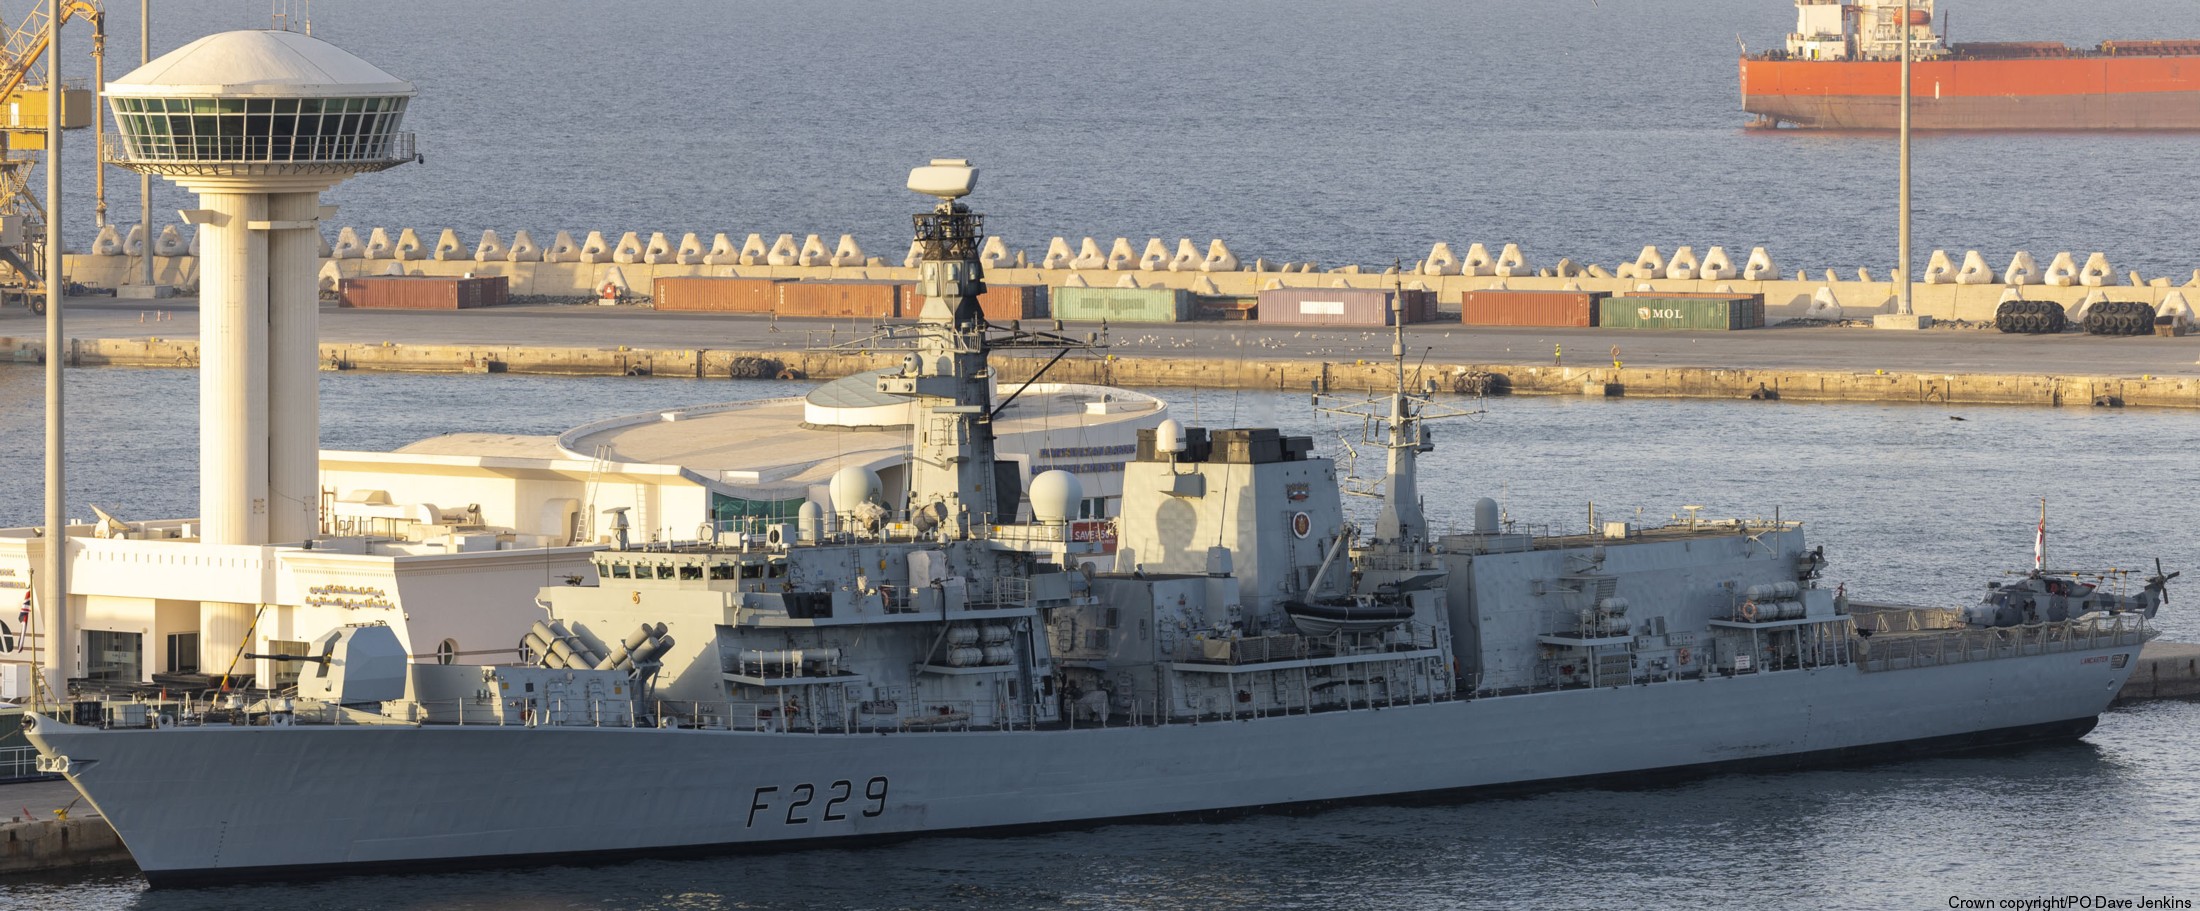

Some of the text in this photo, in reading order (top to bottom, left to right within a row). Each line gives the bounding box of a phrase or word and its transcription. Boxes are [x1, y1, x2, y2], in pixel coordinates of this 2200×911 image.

[1652, 308, 1684, 319] MOL
[1075, 530, 1095, 540] SAVE
[2081, 656, 2108, 665] LANCASTER
[746, 775, 889, 828] F229
